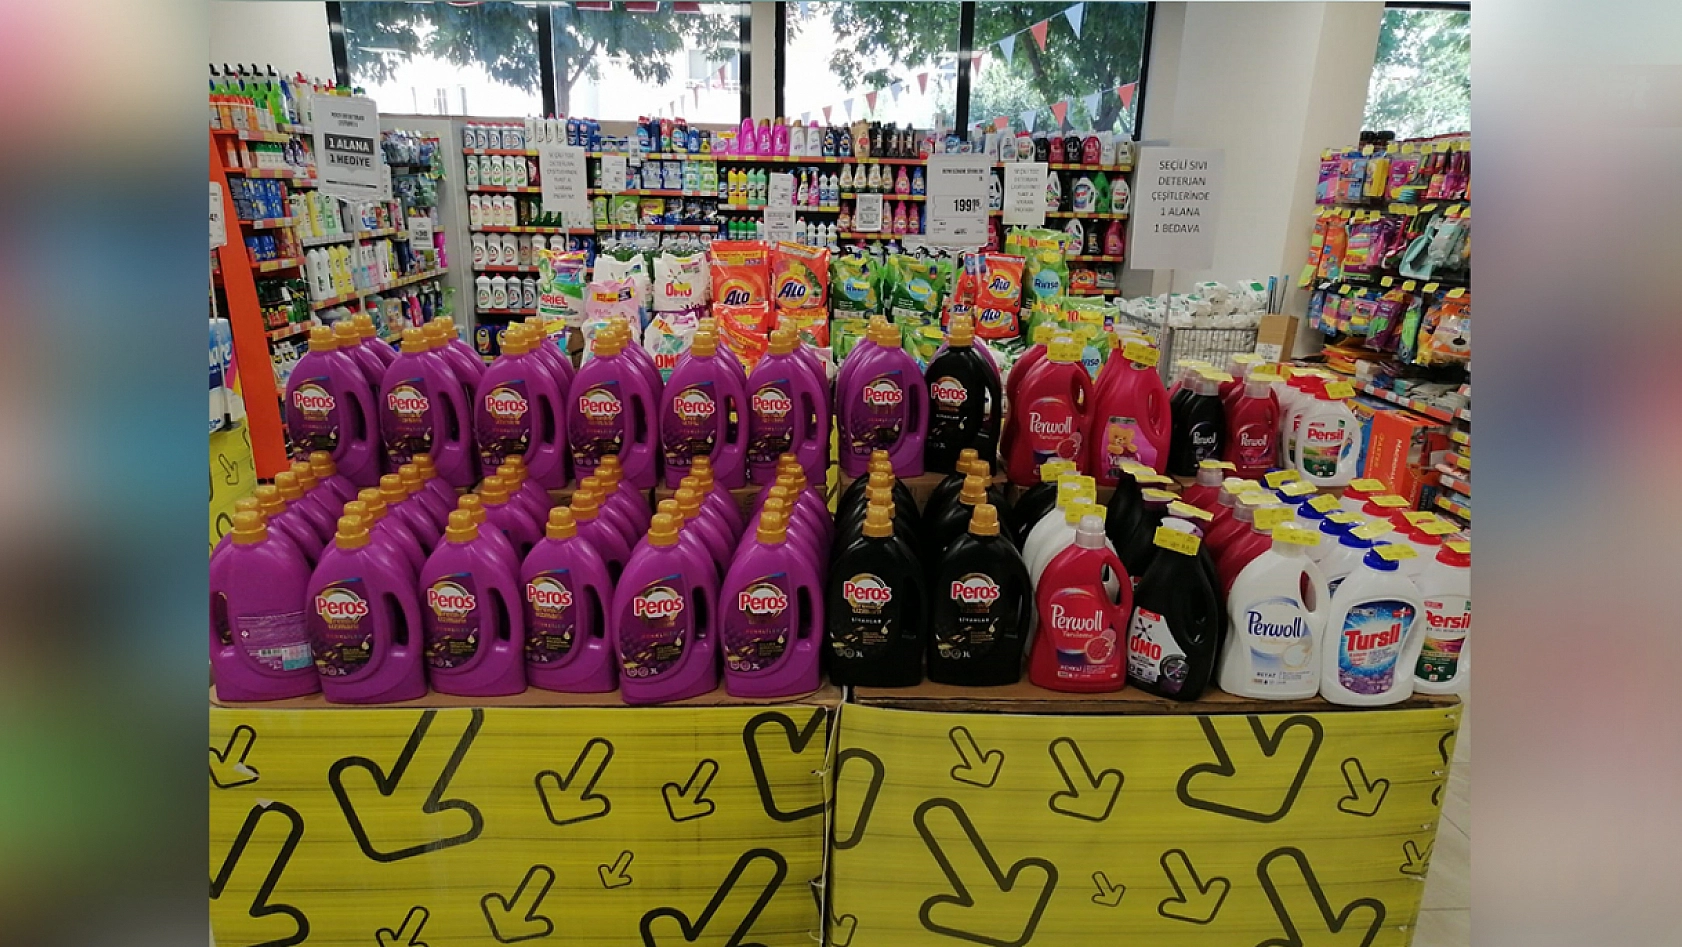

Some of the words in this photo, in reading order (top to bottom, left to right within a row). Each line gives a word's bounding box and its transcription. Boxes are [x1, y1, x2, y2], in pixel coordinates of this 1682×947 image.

[328, 137, 336, 147] 1
[337, 138, 370, 152] ALANA
[329, 154, 337, 163] 1
[337, 154, 371, 167] HEDİYE
[1159, 159, 1187, 171] SEÇİLİ
[1189, 160, 1208, 171] SIVI
[1158, 176, 1206, 186] DETERJAN
[1151, 190, 1211, 202] ÇEŞİTLERİNDE
[953, 199, 972, 212] 199
[1160, 207, 1166, 216] 1
[1168, 207, 1201, 216] ALANA
[1154, 223, 1160, 233] 1
[1162, 223, 1200, 233] BEDAVA
[541, 293, 569, 305] ARIEL
[294, 392, 335, 409] Peros
[865, 387, 902, 402] Peros
[931, 384, 967, 401] Peros
[389, 394, 428, 411] Peros
[486, 397, 527, 412] Peros
[580, 398, 621, 413] Peros
[675, 398, 715, 414] Peros
[753, 395, 791, 411] Peros
[1029, 412, 1073, 433] Perwoll
[1307, 427, 1345, 442] Persil
[527, 584, 572, 605] Peros
[844, 582, 891, 600] Peros
[952, 582, 999, 600] Peros
[317, 597, 368, 615] Peros
[428, 590, 475, 609] Peros
[635, 597, 683, 614] Peros
[740, 592, 787, 610] Peros
[1050, 604, 1103, 632] Perwoll
[1247, 610, 1302, 638] Perwoll
[1344, 623, 1401, 651] Tursil
[1130, 636, 1162, 661] OMO
